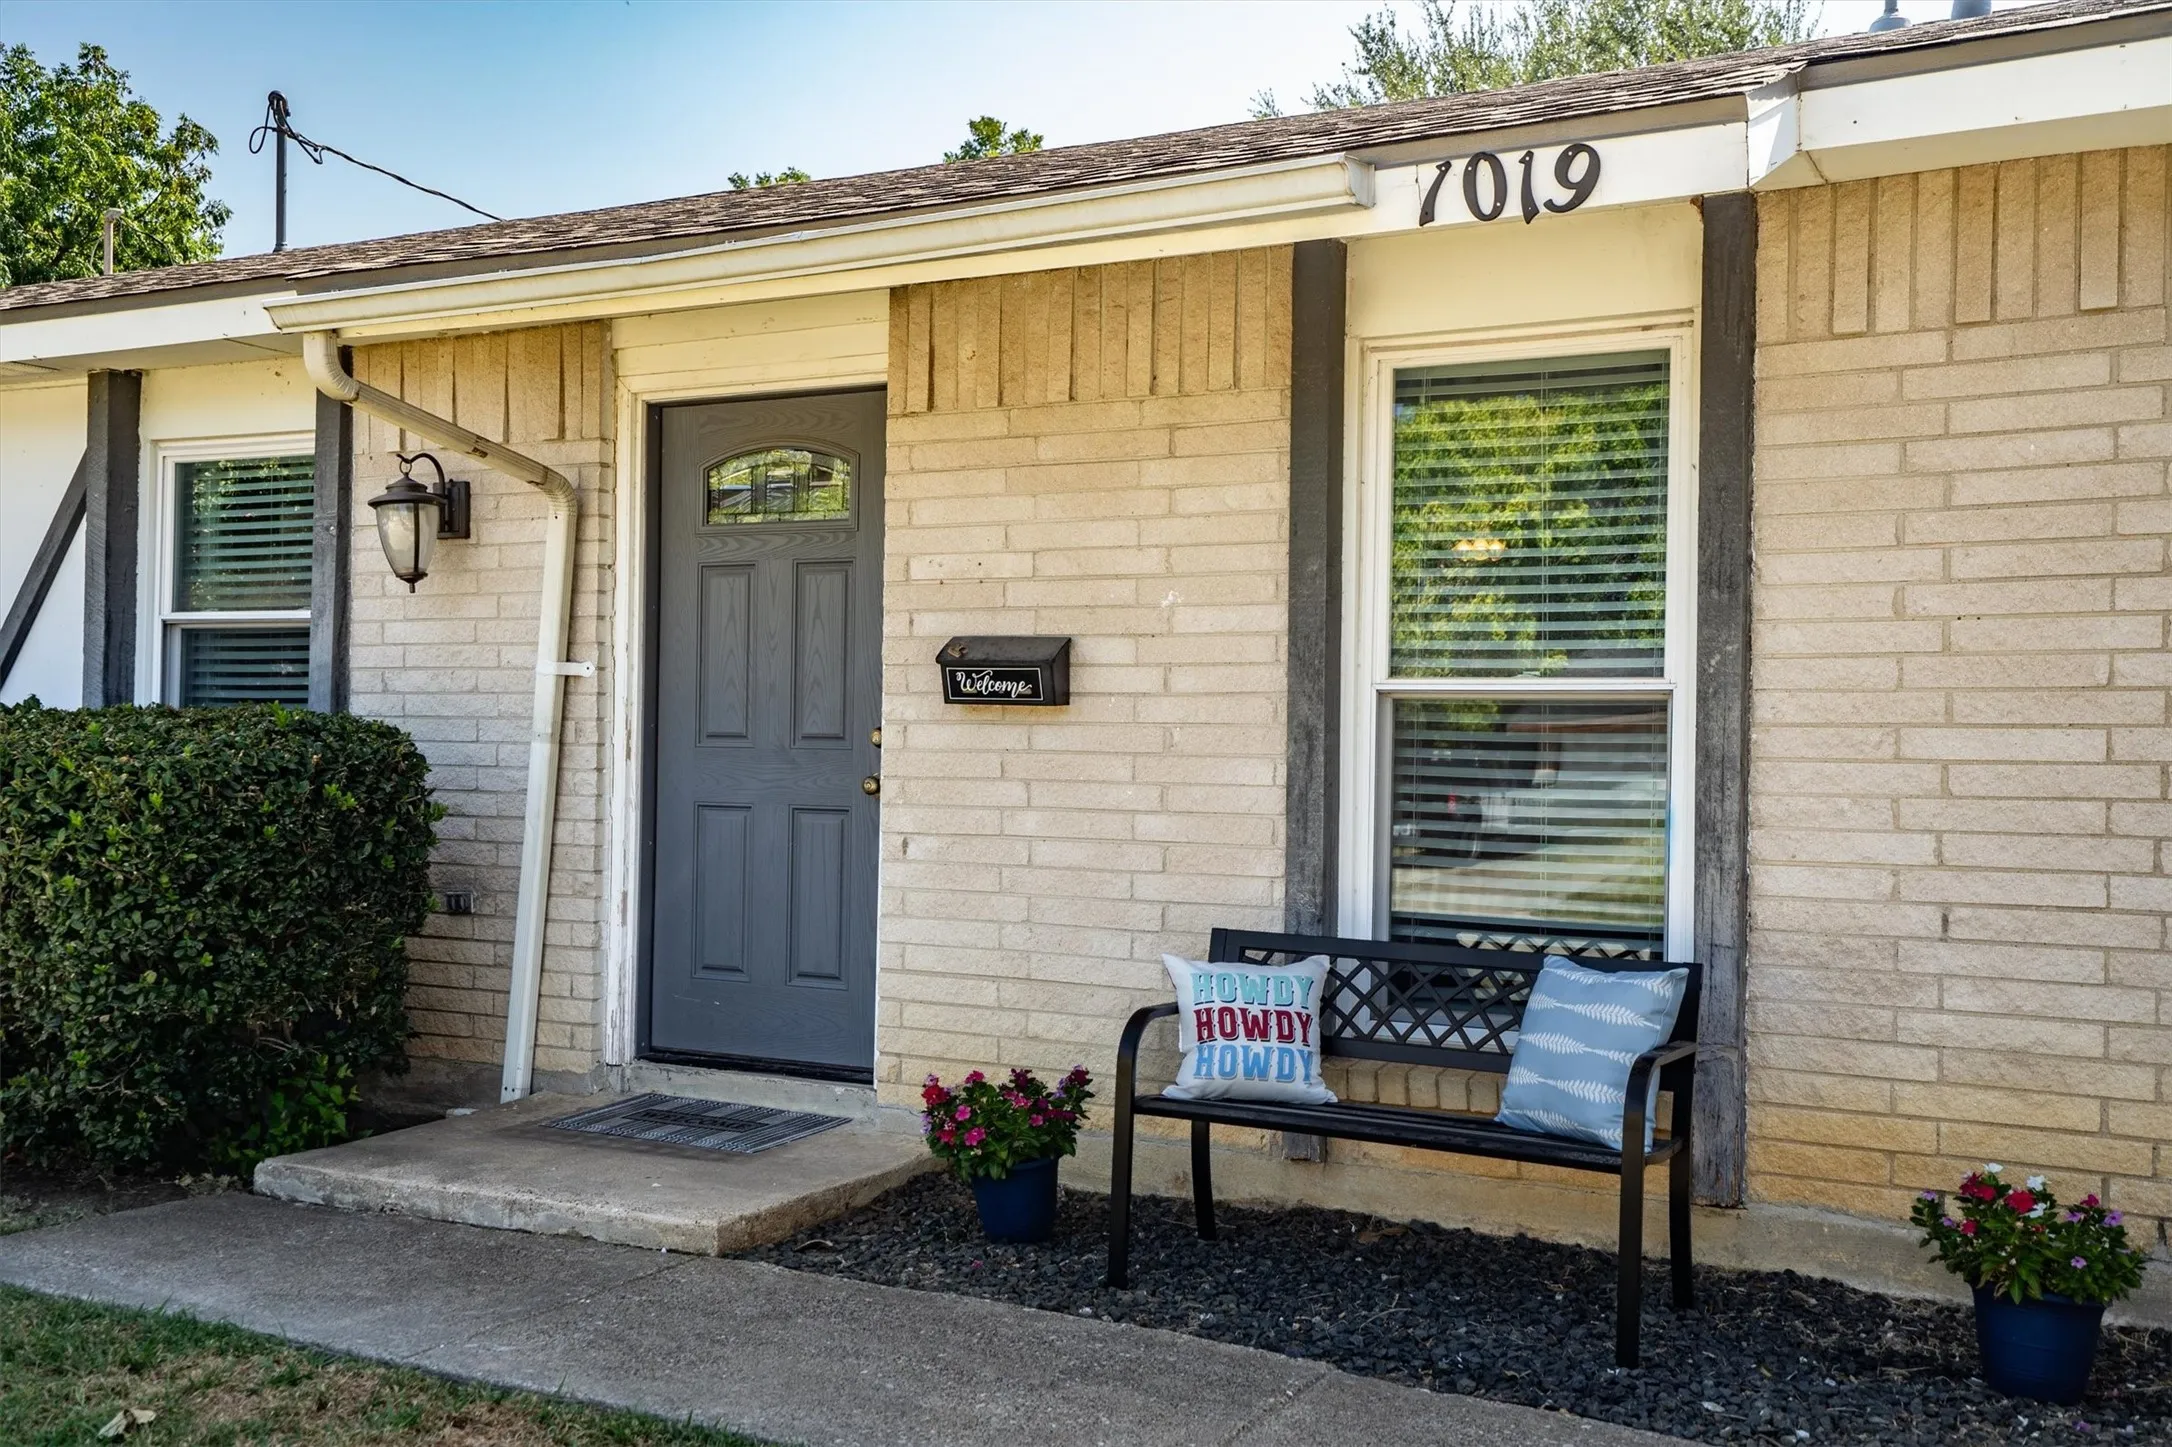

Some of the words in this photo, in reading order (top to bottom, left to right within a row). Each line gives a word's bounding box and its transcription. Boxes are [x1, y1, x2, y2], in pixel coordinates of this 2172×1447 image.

[956, 670, 1033, 698] Welcome
[1191, 972, 1315, 1009] HOWDY
[1194, 1006, 1313, 1047] HOWDY
[1193, 1044, 1314, 1084] HOWDY
